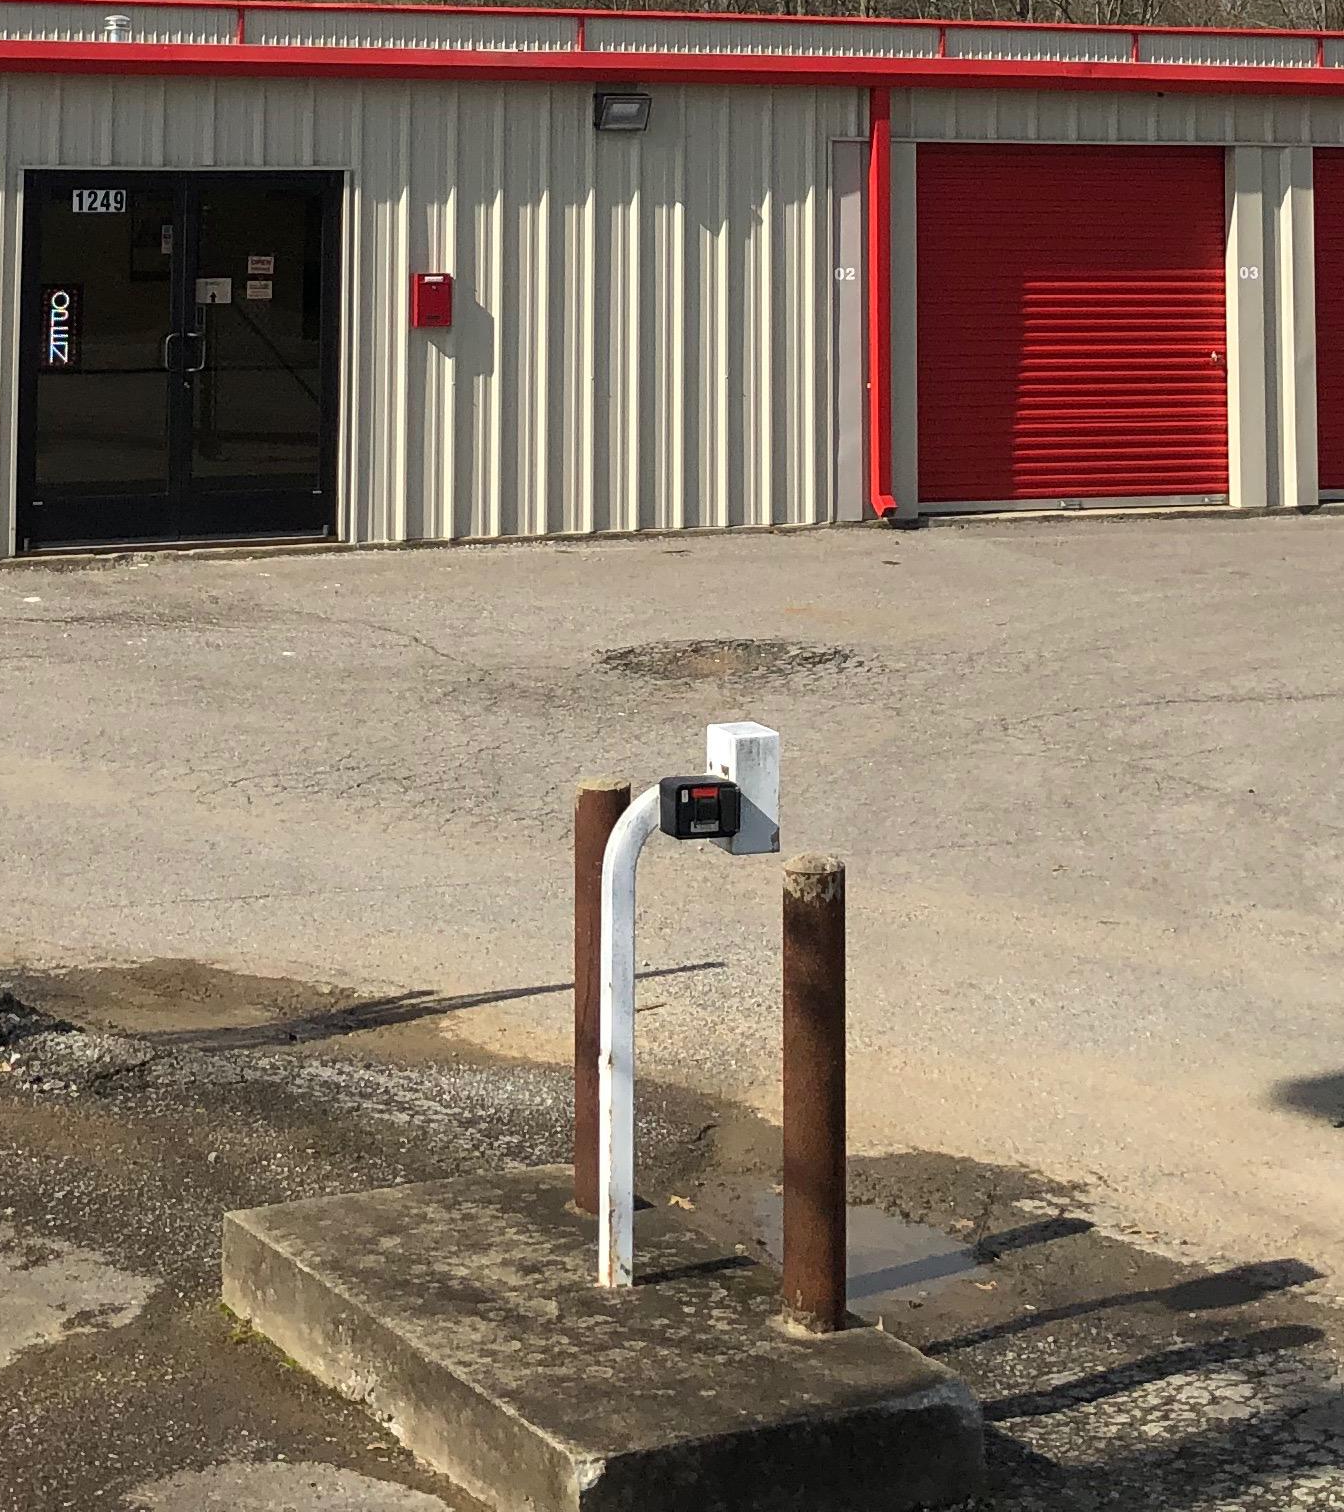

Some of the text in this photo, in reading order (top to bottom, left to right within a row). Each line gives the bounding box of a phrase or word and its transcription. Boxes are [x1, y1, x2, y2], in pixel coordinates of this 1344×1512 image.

[75, 190, 125, 212] 1249
[834, 267, 856, 281] 02
[1240, 266, 1259, 279] 03
[49, 290, 70, 364] OPEN
